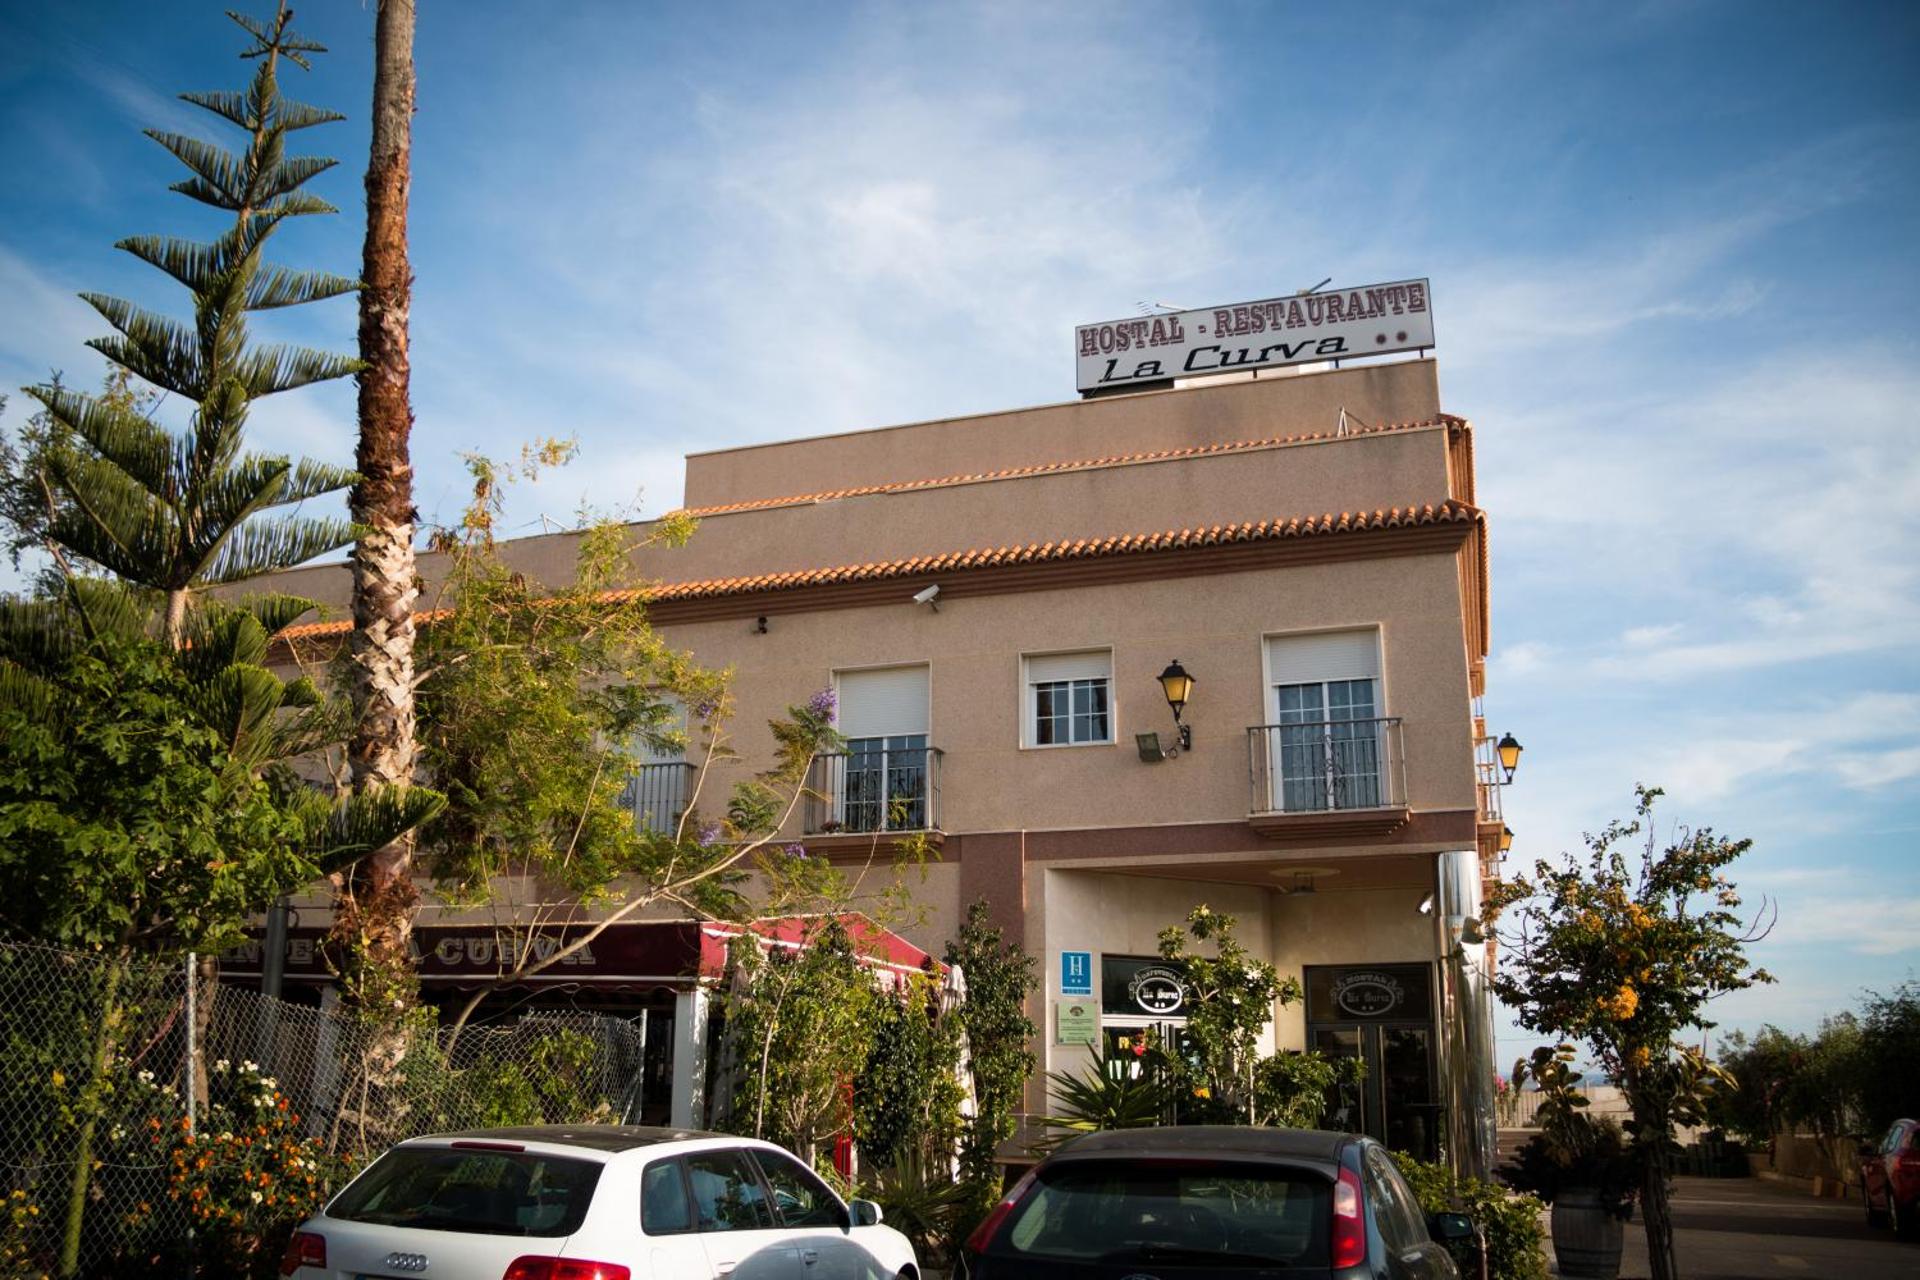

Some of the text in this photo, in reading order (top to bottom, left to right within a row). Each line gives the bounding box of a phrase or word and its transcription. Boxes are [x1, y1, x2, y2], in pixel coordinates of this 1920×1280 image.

[1080, 316, 1185, 356] HOSTAL
[1214, 283, 1427, 339] RESTAURANTE
[1098, 335, 1349, 383] La Curva
[437, 937, 597, 965] CURVA
